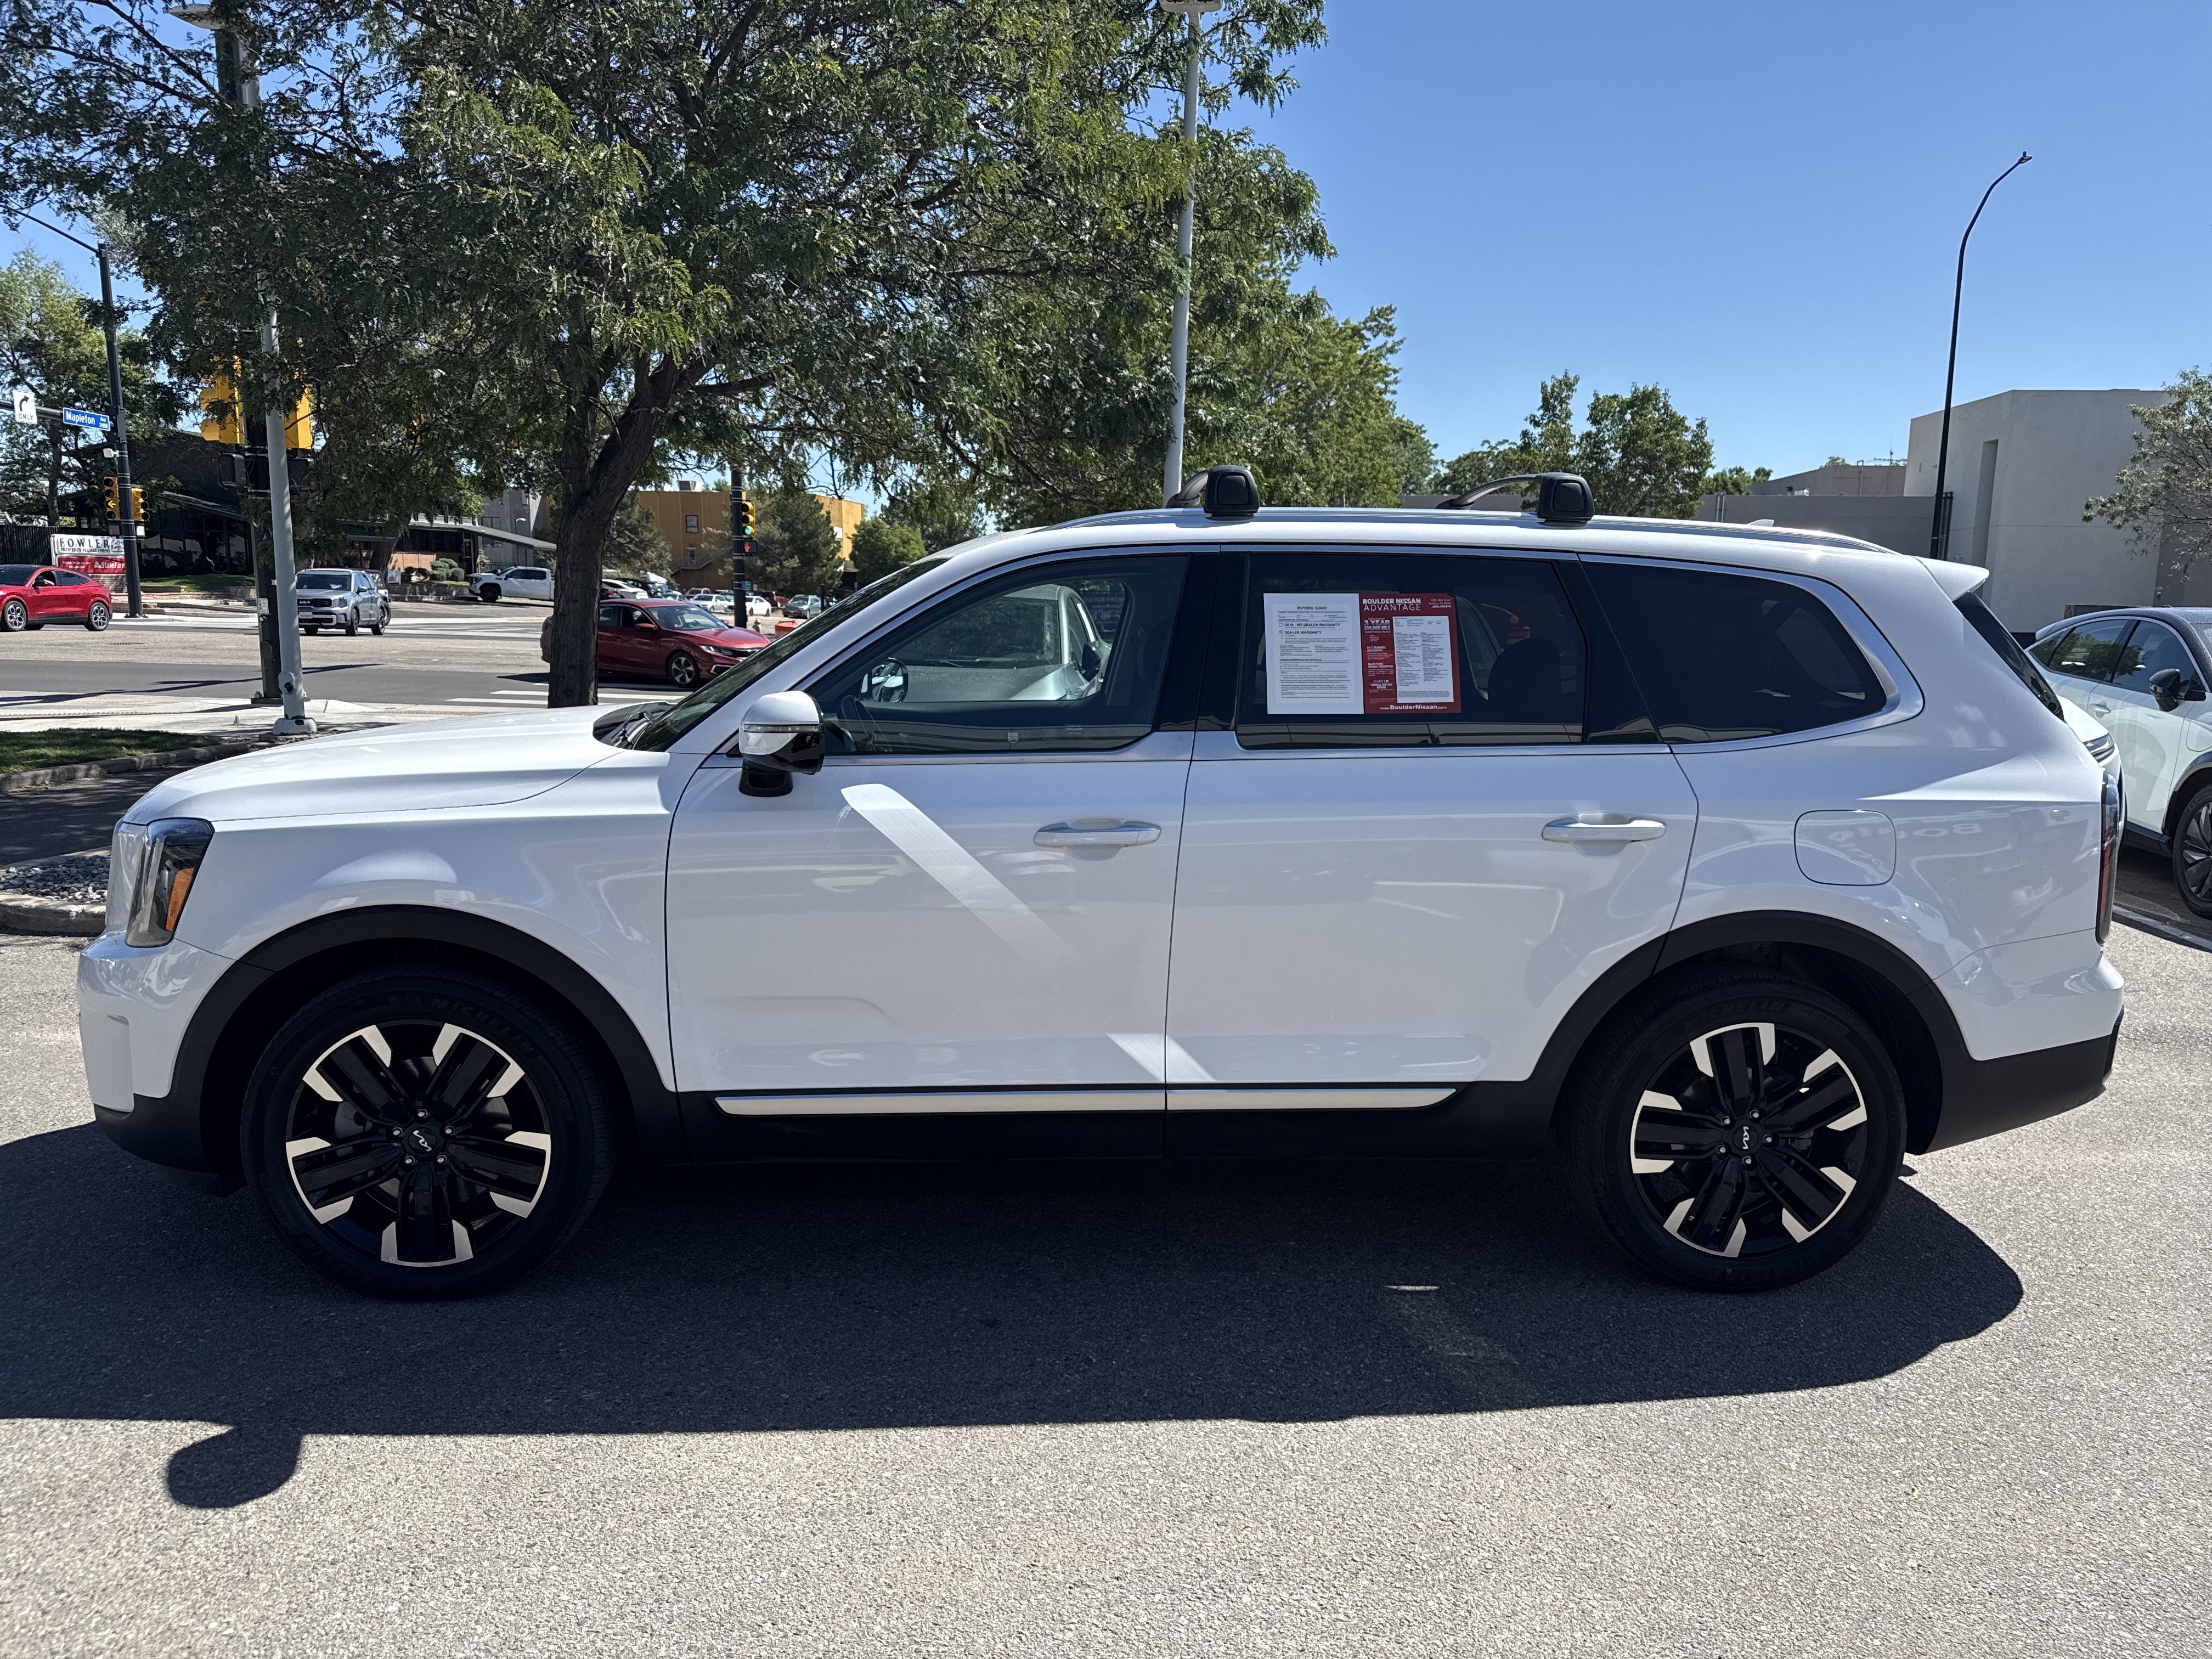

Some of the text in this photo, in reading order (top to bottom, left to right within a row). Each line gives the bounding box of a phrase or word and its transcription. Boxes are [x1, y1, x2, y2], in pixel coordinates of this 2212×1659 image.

[66, 411, 95, 425] Mapleton
[59, 538, 110, 549] FOWLER
[430, 997, 537, 1054] MICHELIN
[1682, 1001, 1784, 1031] MICHELIN
